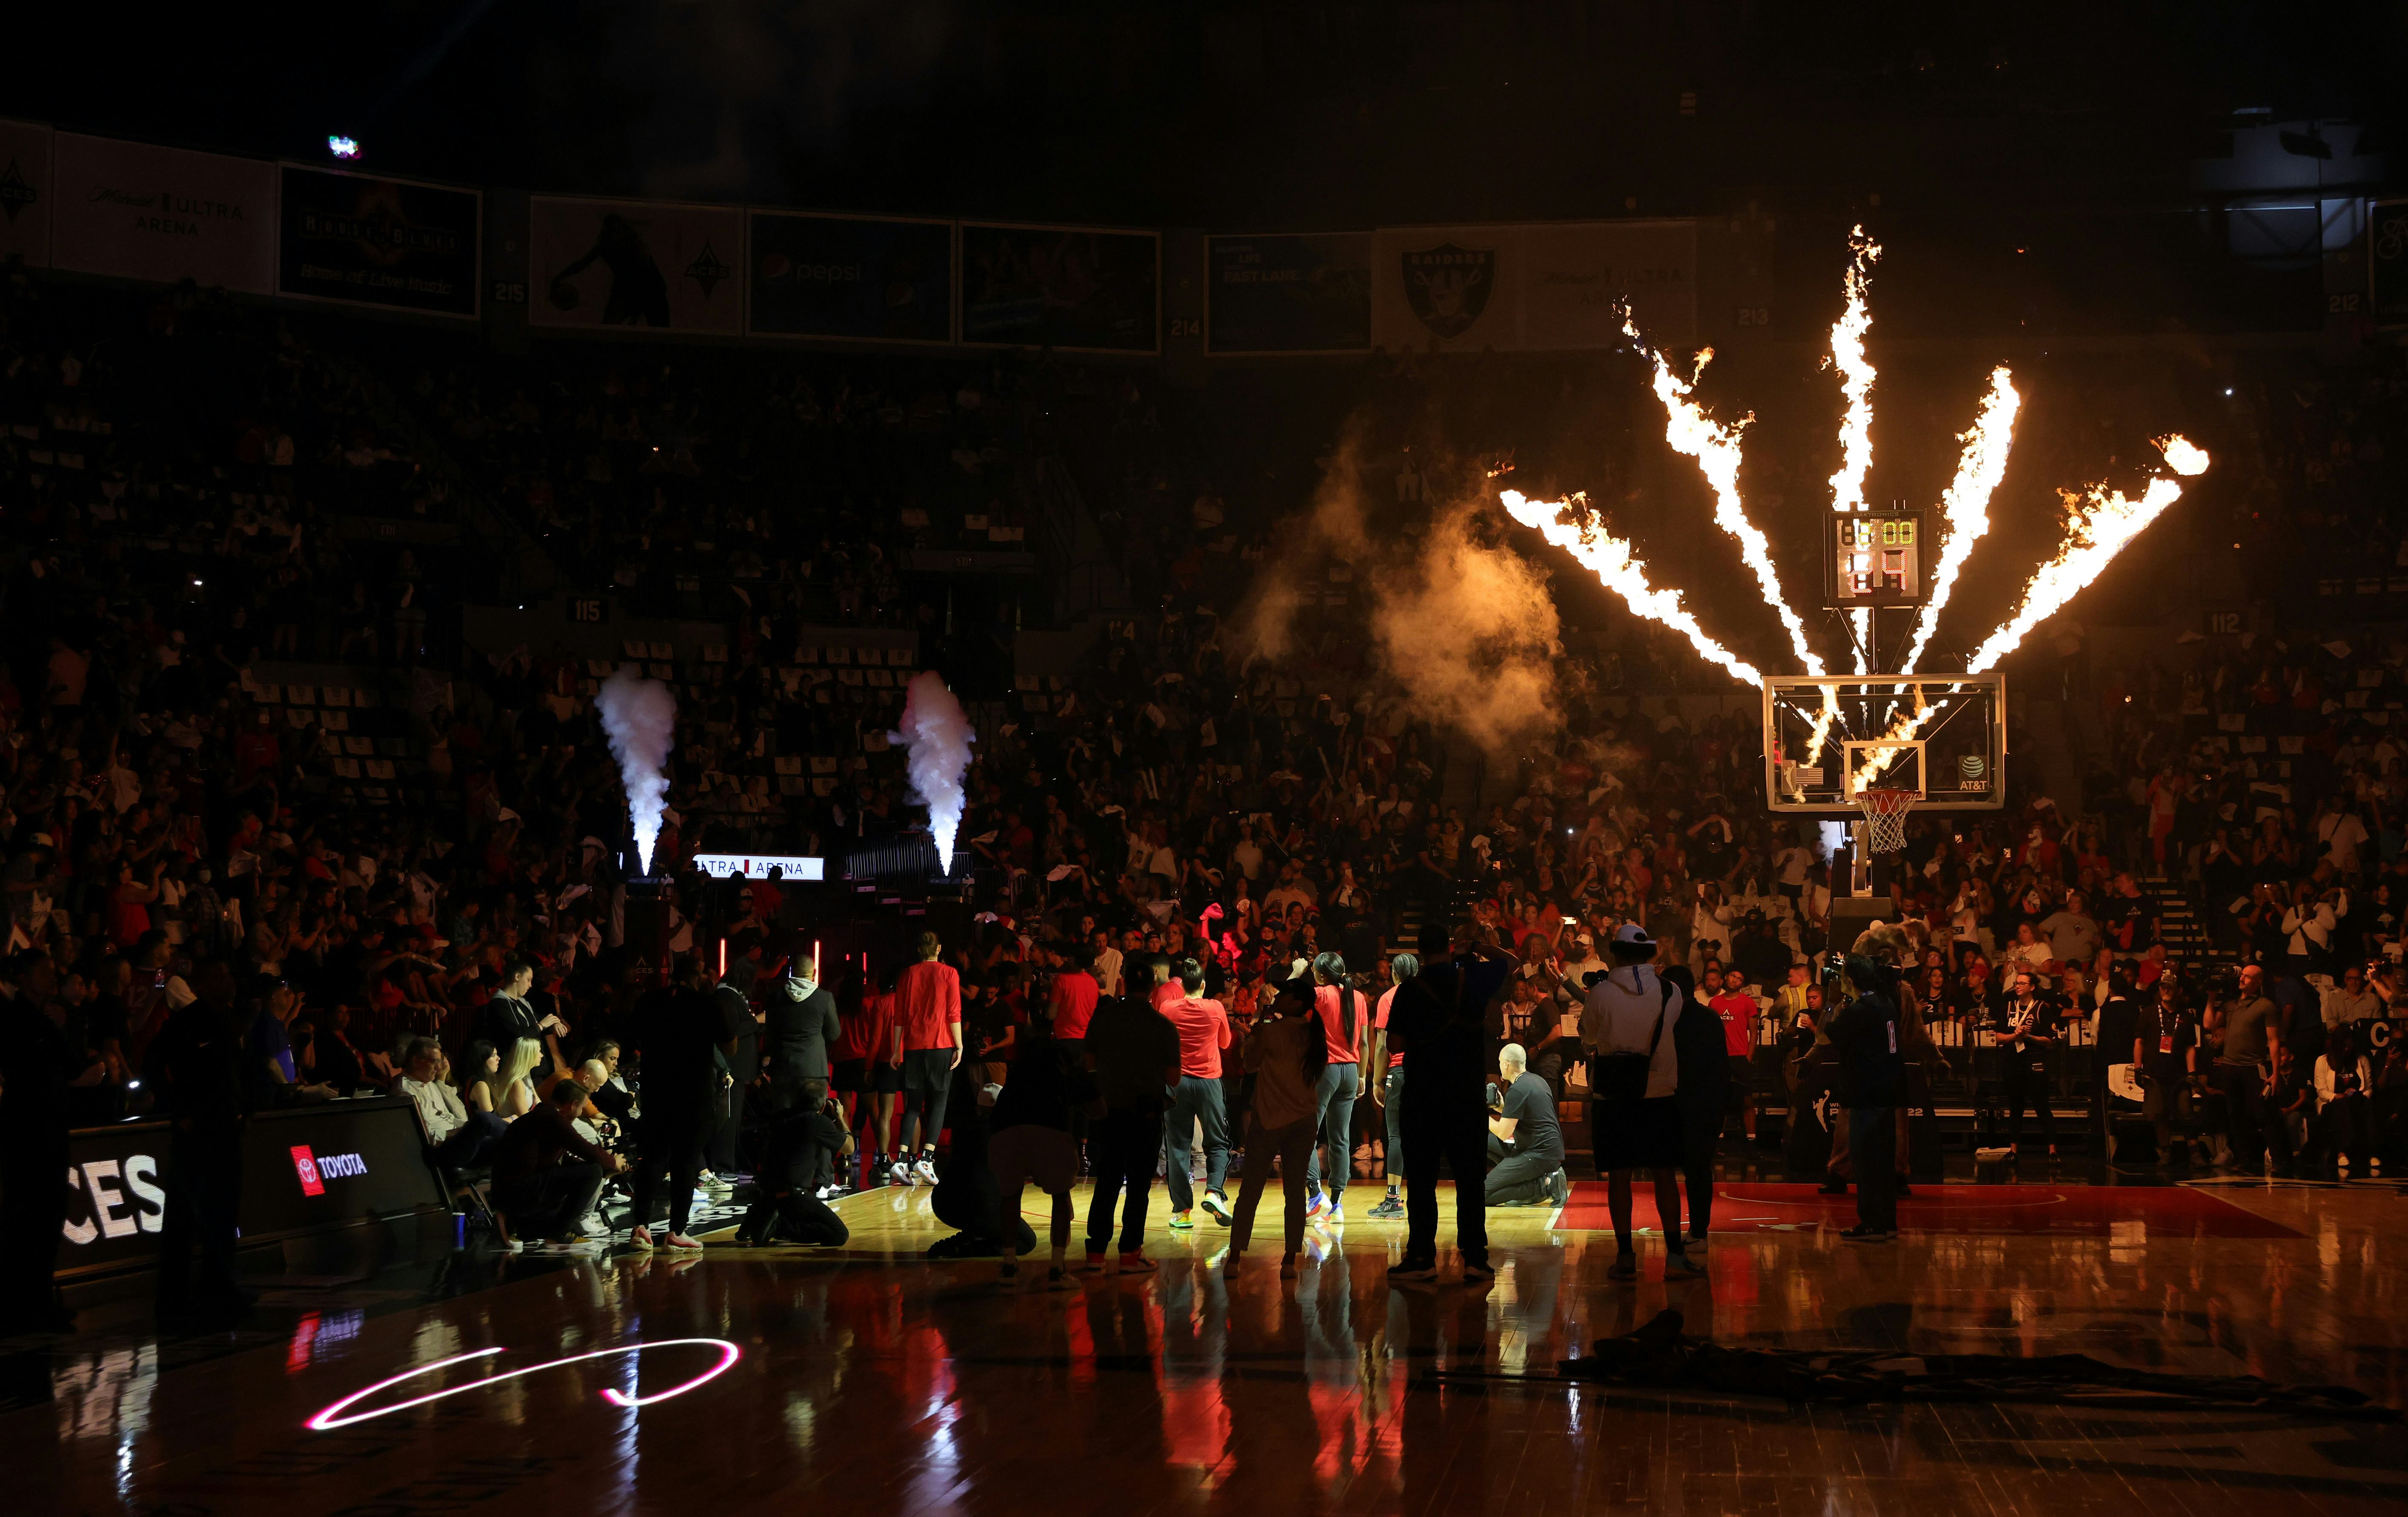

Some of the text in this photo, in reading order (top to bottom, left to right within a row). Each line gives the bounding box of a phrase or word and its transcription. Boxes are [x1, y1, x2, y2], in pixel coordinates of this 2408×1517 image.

[177, 197, 243, 220] ULTRA
[136, 217, 198, 236] ARENA
[1239, 254, 1261, 263] LIFE
[1411, 253, 1485, 265] RAIDERS
[300, 264, 452, 295] Home of Live Music
[687, 266, 728, 277] ACES
[797, 263, 860, 284] pepsi
[1224, 269, 1301, 283] FAST LANE
[496, 283, 524, 302] 215
[2329, 293, 2359, 313] 212
[1738, 308, 1768, 326] 213
[1171, 320, 1200, 336] 214
[1850, 550, 1906, 593] 24
[575, 599, 600, 621] 115
[2212, 613, 2239, 633] 112
[1960, 780, 1987, 790] AT&T
[316, 1152, 368, 1179] TOYOTA
